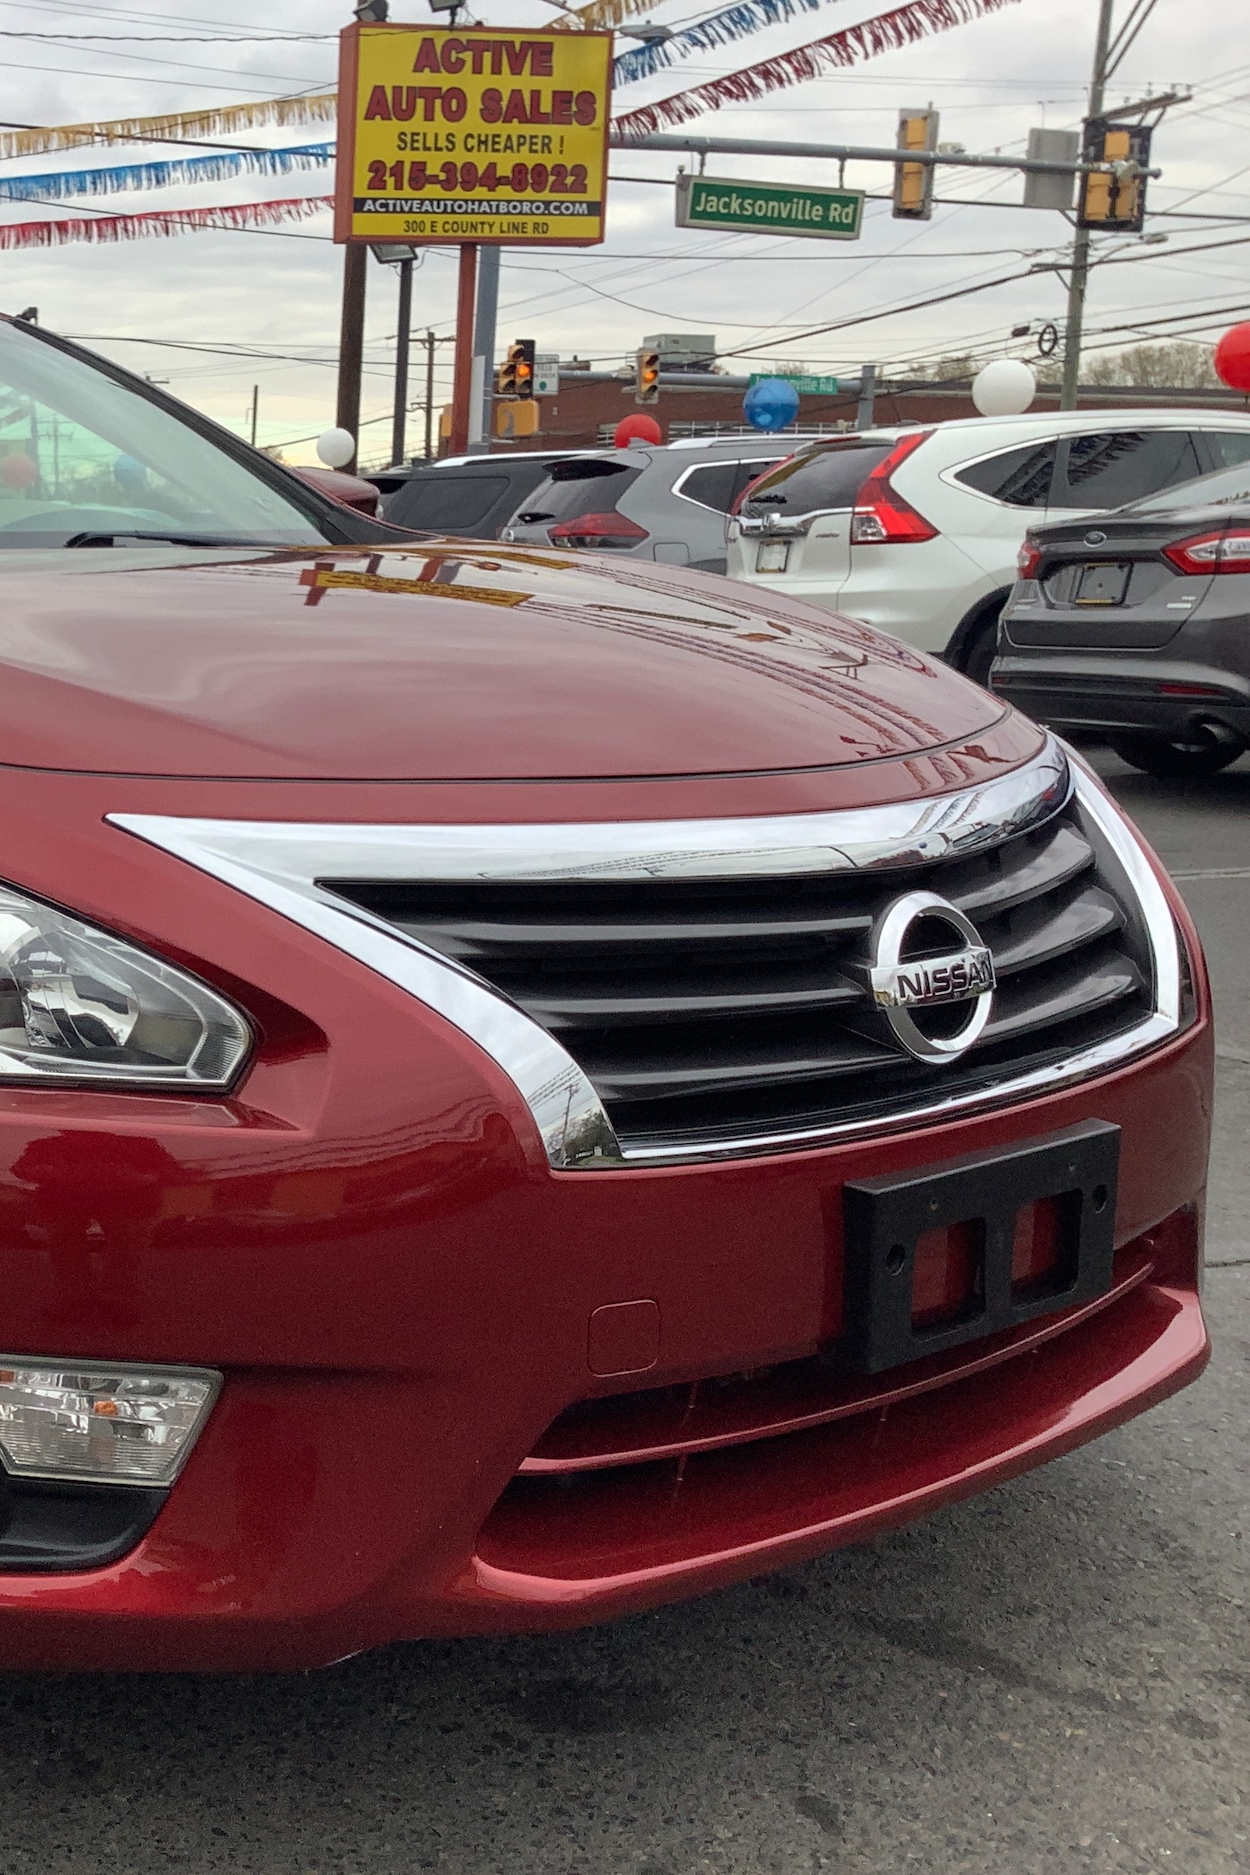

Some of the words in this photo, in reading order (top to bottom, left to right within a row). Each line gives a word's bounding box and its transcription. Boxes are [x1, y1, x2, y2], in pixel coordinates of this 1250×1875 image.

[412, 37, 554, 77] ACTIVE
[363, 84, 468, 123] AUTO
[479, 88, 597, 126] SALES
[396, 131, 456, 152] SELLS
[463, 134, 552, 154] CHEAPER
[366, 159, 588, 194] 215-394-8922
[362, 198, 589, 215] ACTIVEAUTOHATBORO.COM
[695, 192, 823, 221] Jacksonville
[829, 203, 854, 223] Rd
[403, 220, 426, 233] 300
[430, 221, 438, 233] E
[442, 221, 495, 234] COUNTY
[499, 222, 528, 233] LINE
[532, 222, 549, 234] RD
[897, 951, 993, 1000] NISSAN
